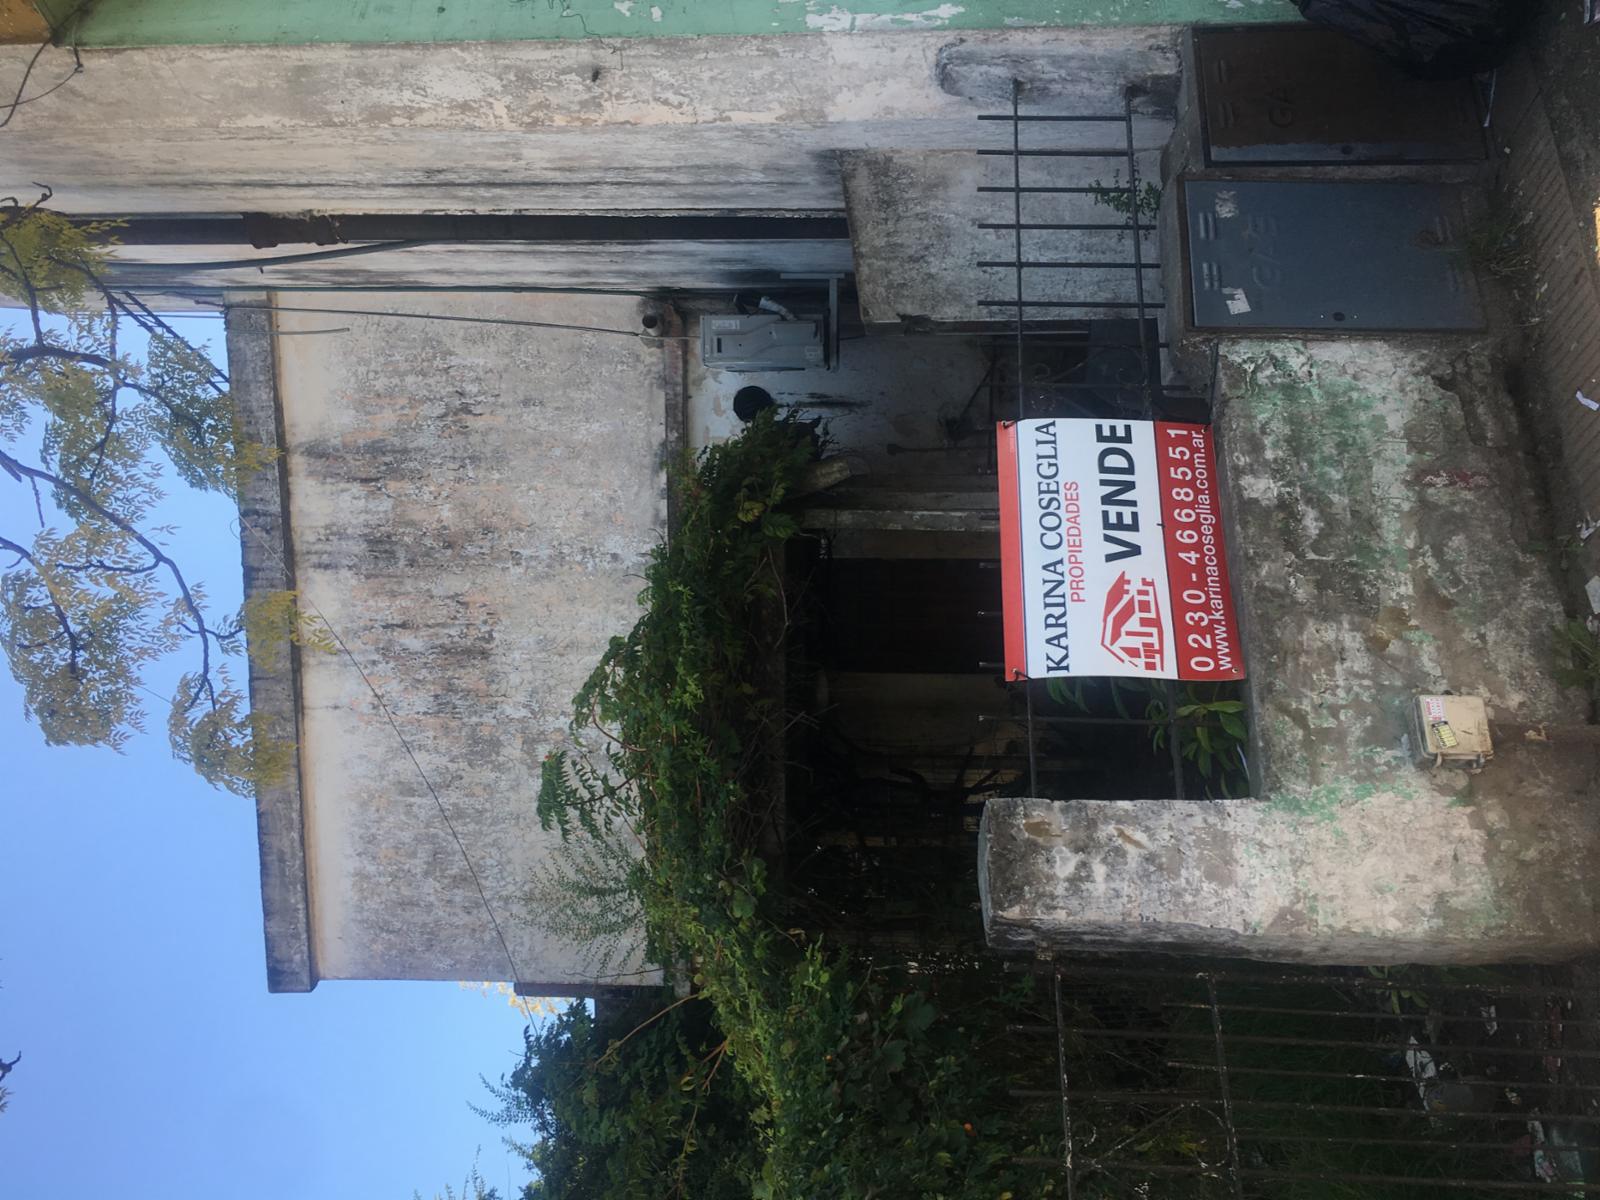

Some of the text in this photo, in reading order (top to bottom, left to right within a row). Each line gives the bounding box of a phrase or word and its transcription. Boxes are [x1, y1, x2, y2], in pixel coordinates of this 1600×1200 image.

[1034, 420, 1070, 674] KARINA COSEGLIA
[1063, 481, 1086, 603] PROPIEDADES
[1095, 423, 1142, 563] VENDE
[1191, 430, 1233, 671] www.karinacoseglia.com.ar
